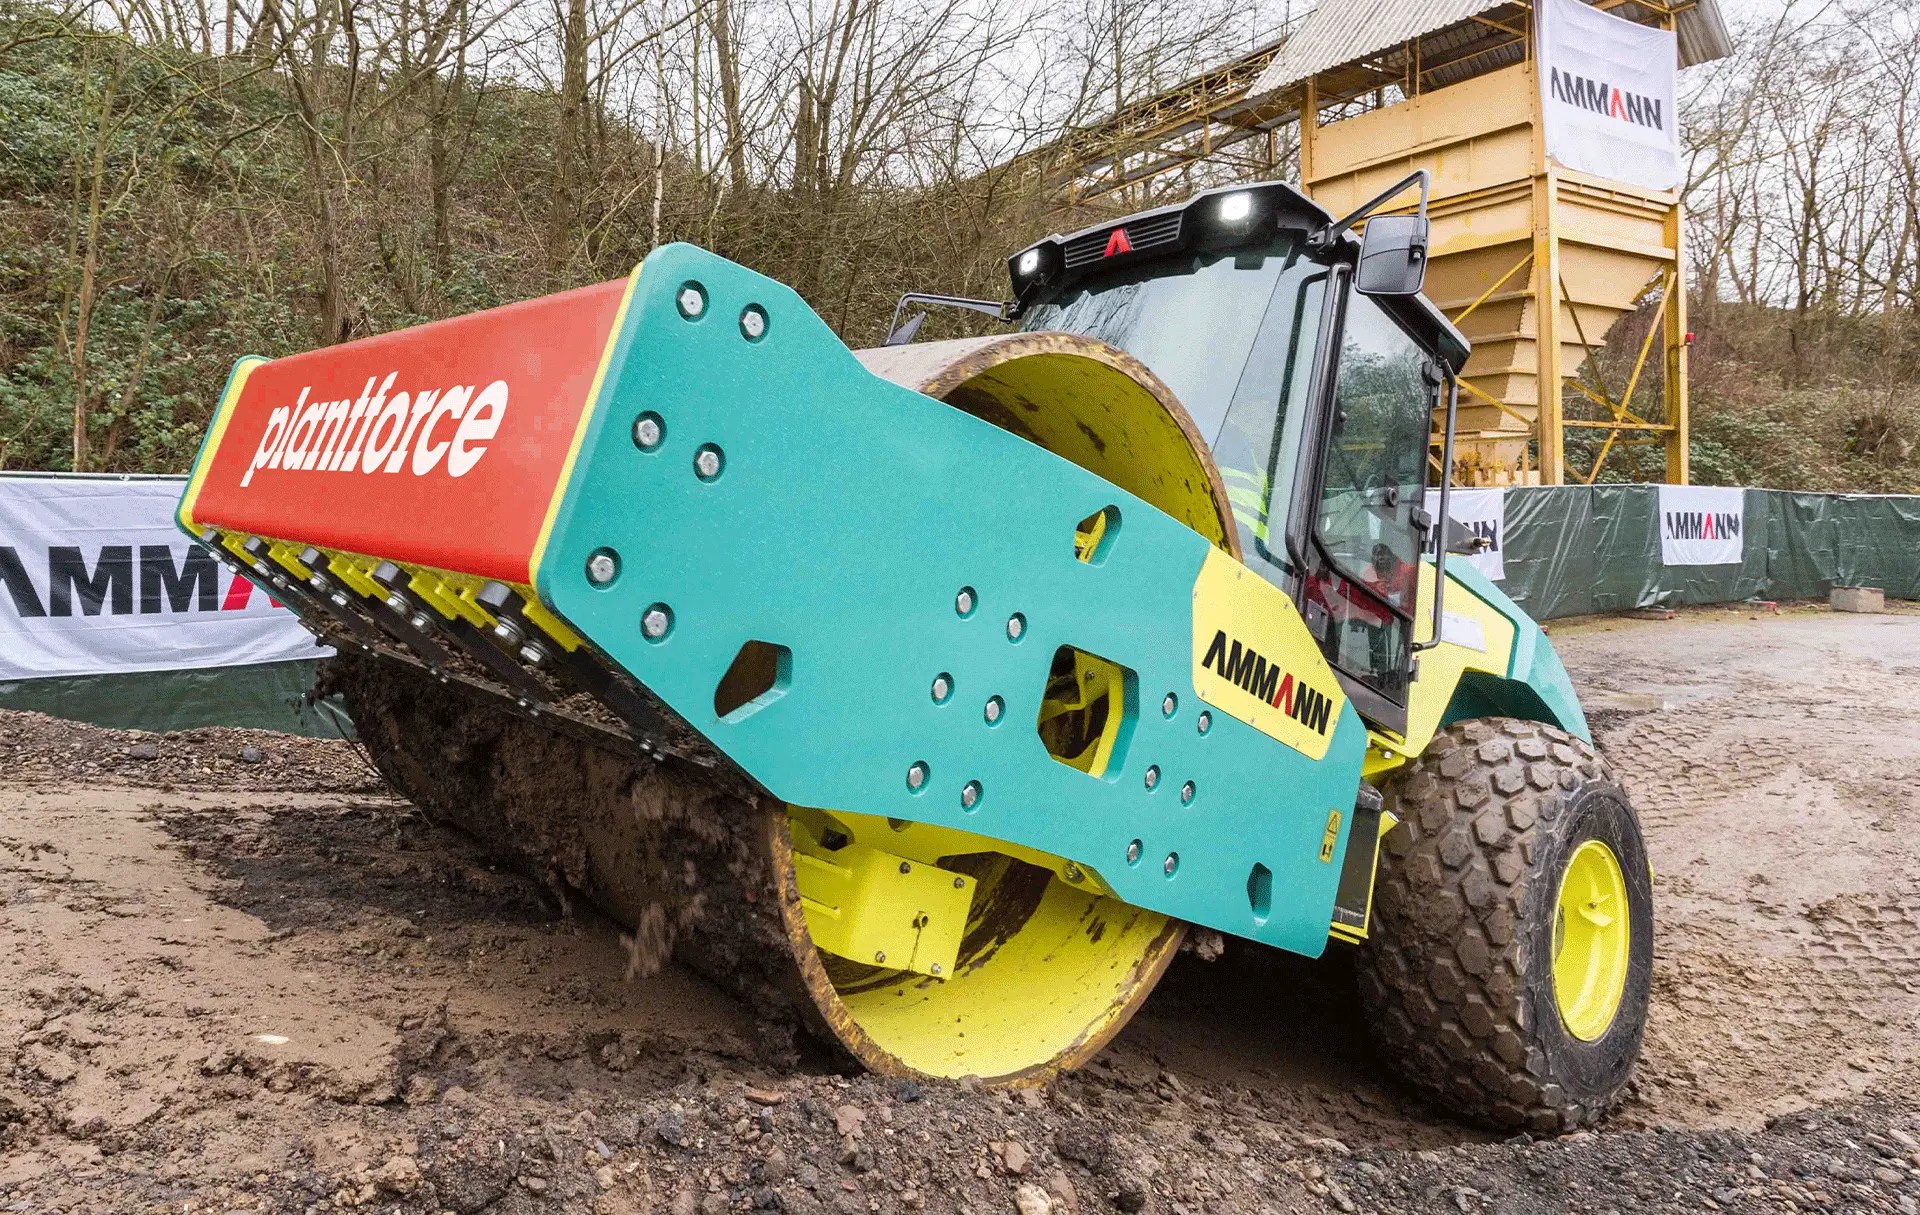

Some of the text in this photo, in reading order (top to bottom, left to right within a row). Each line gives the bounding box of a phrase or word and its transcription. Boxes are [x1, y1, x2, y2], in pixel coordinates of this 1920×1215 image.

[1551, 66, 1663, 131] AMMANN
[239, 371, 509, 488] plantforce
[1666, 511, 1740, 540] AMMANN
[1201, 629, 1333, 737] AMMANN
